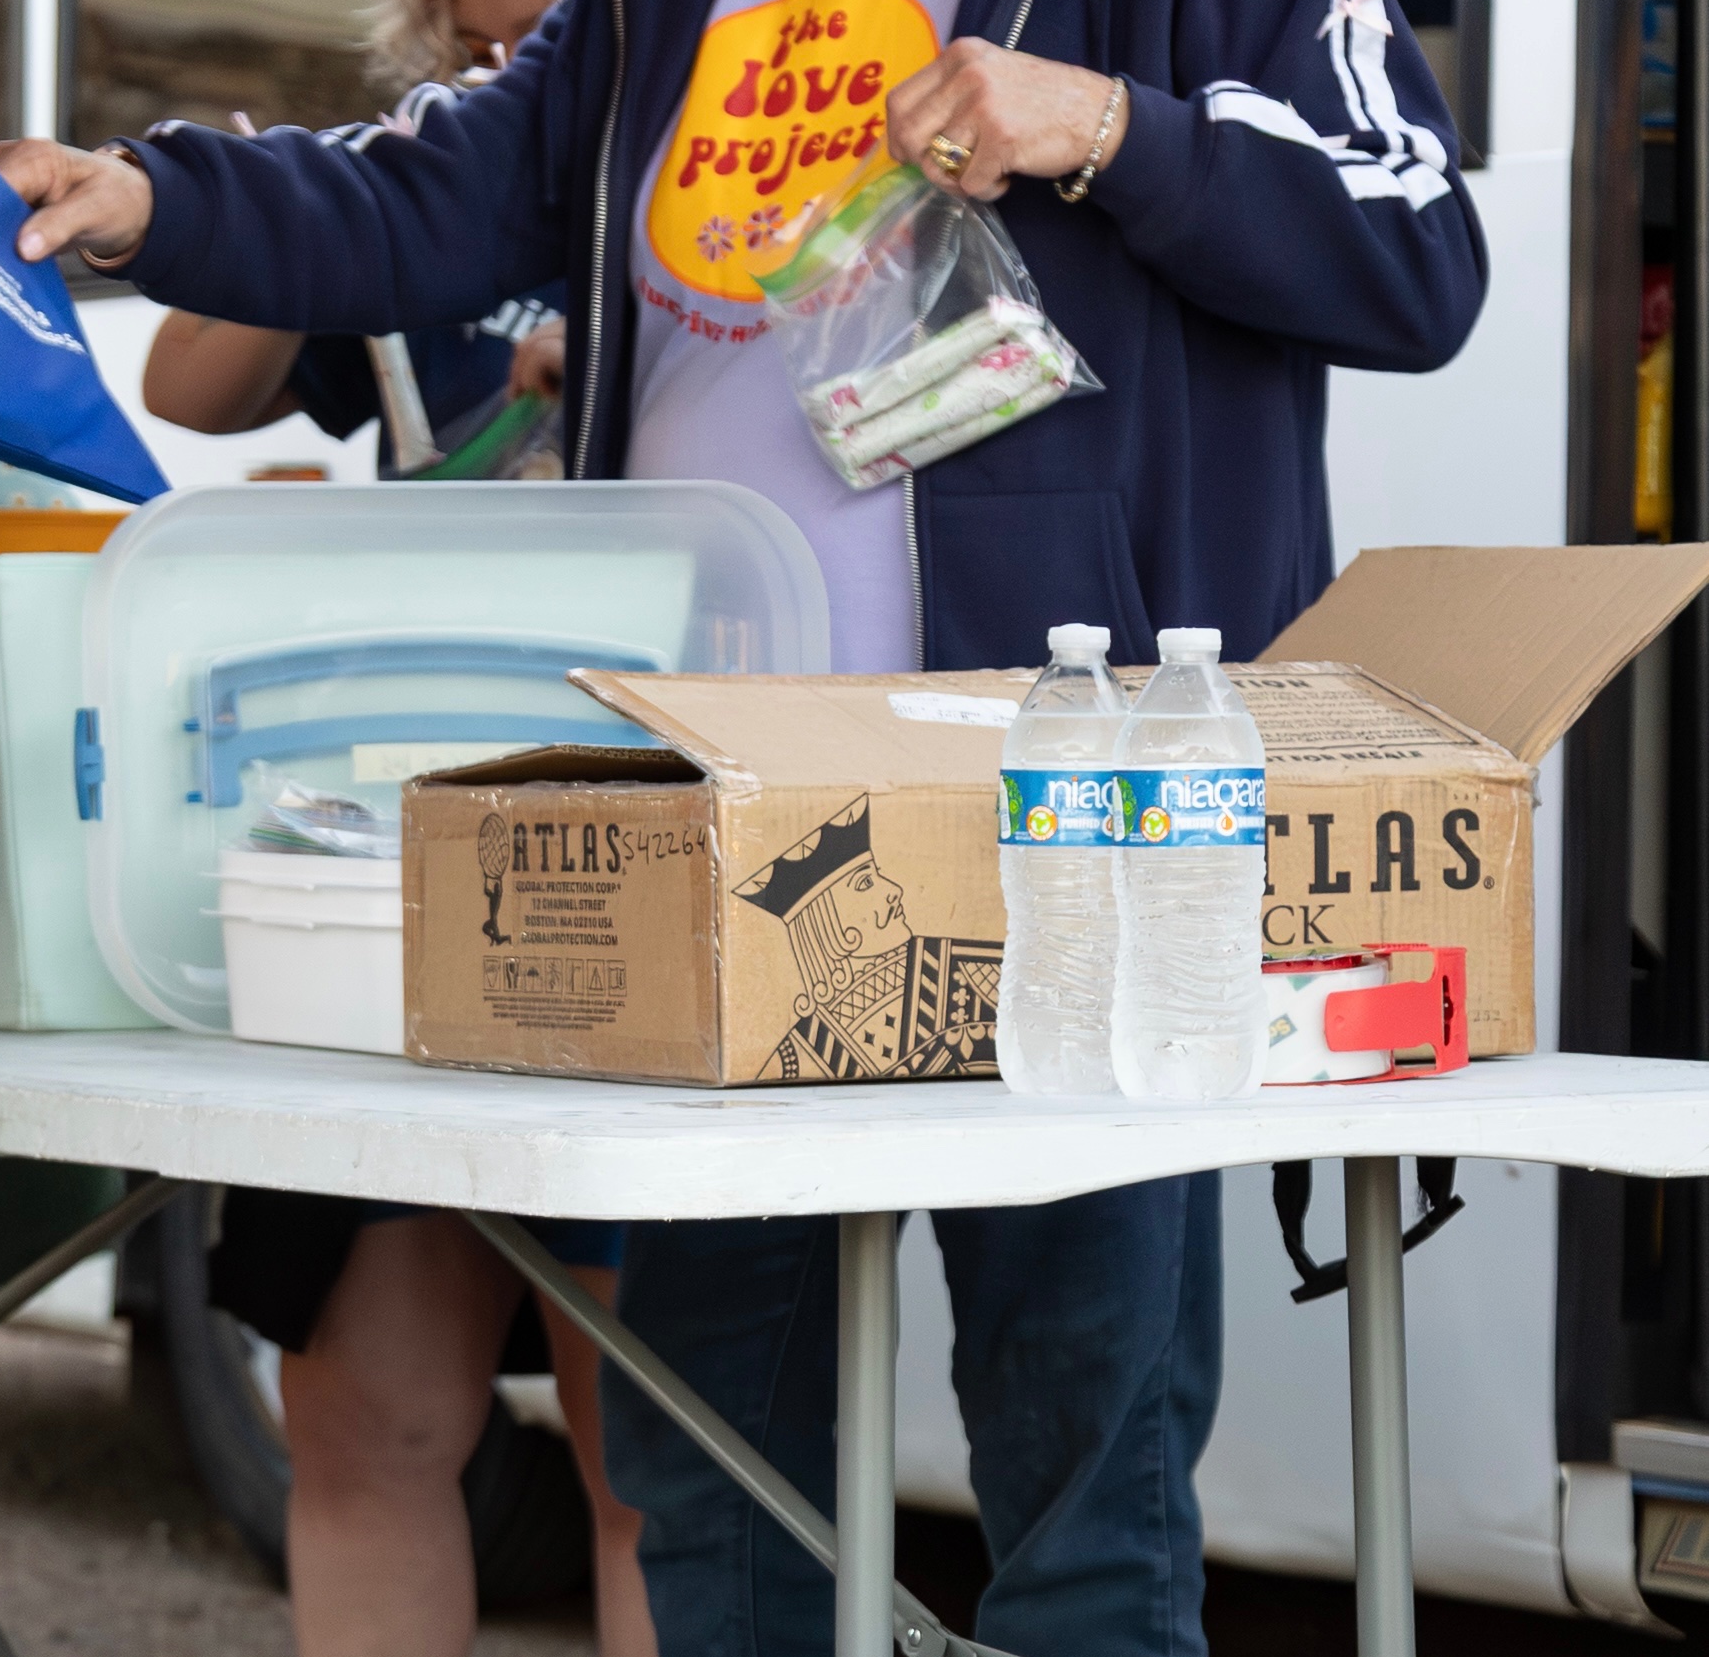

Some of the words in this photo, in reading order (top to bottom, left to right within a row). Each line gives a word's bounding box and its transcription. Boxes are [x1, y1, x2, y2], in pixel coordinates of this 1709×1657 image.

[771, 8, 848, 70] the
[723, 59, 885, 118] love
[678, 112, 886, 196] project
[1160, 775, 1266, 837] niagara
[512, 821, 622, 874] ATLAS
[1264, 807, 1481, 896] LAS
[516, 880, 546, 893] GLOBAL
[547, 881, 595, 894] PROTECTION
[532, 897, 541, 912] 12
[542, 898, 577, 912] CHANNEL
[579, 899, 607, 912] STREET
[560, 916, 573, 929] MA
[598, 917, 614, 930] USA
